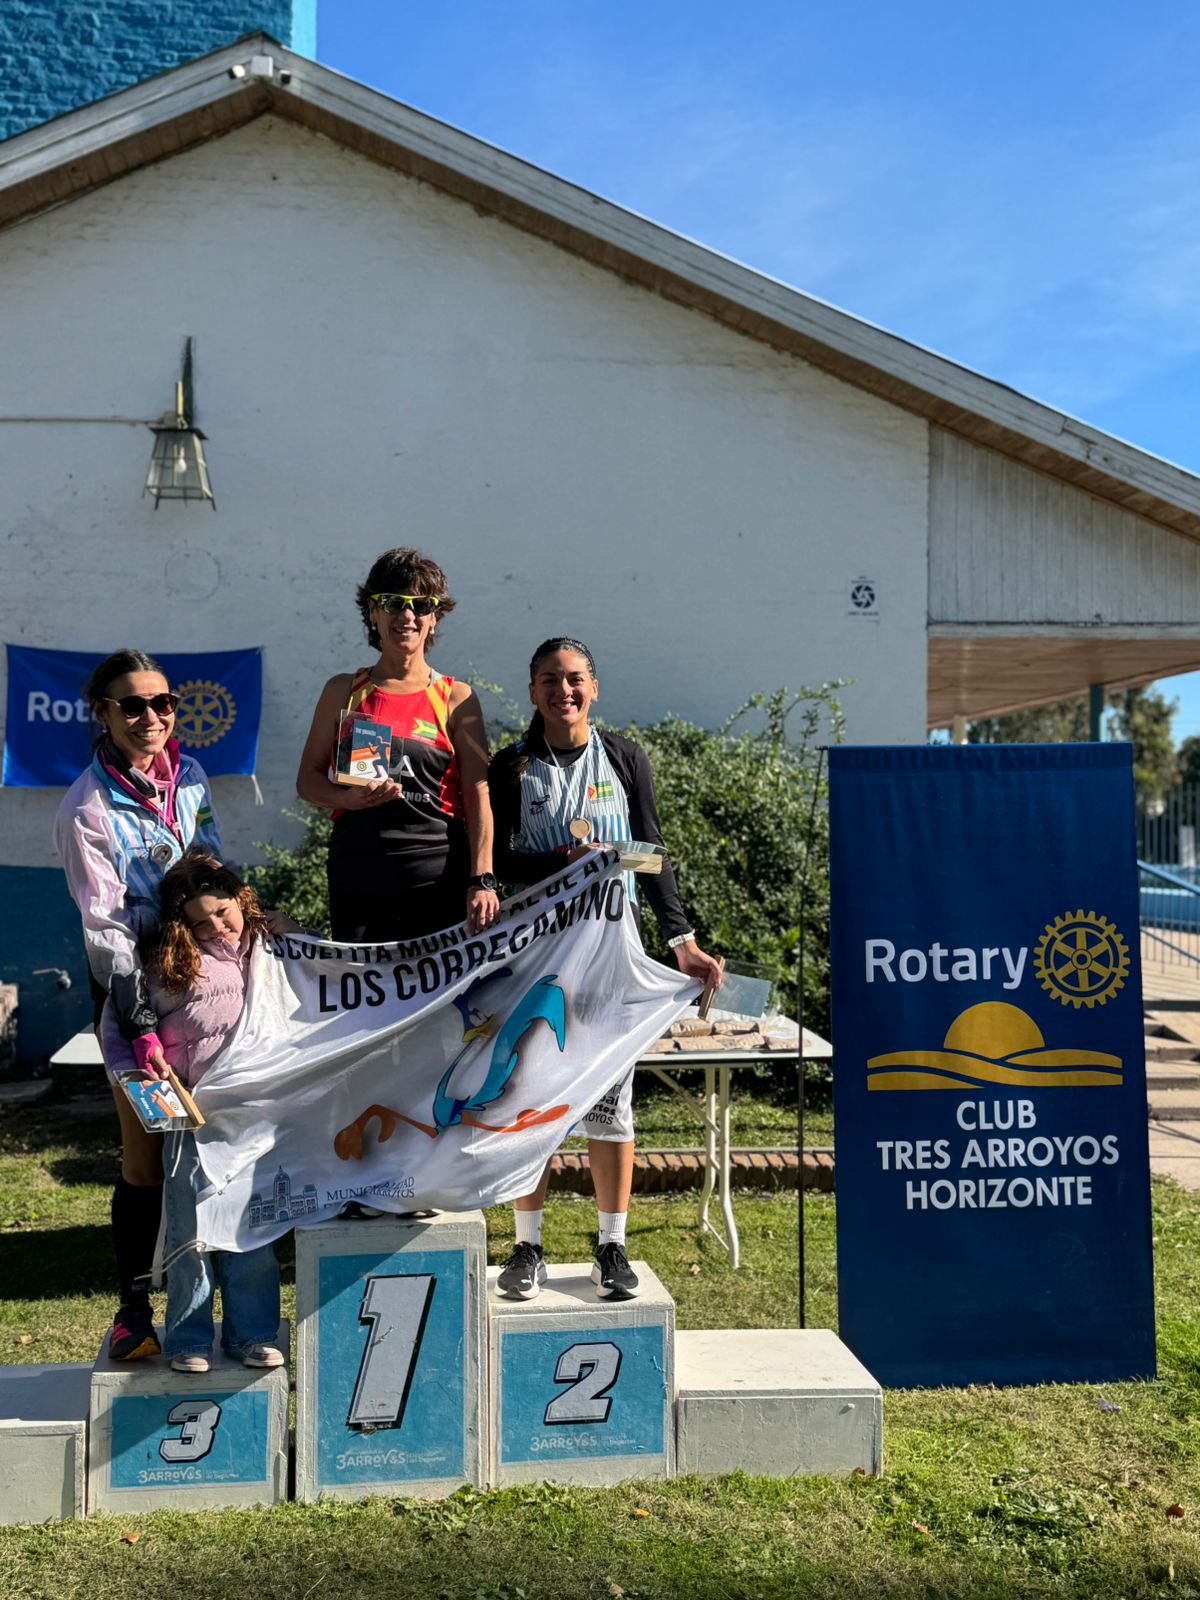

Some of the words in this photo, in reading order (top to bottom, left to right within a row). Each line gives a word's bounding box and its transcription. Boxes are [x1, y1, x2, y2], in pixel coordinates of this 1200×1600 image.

[865, 938, 1029, 990] Rotary
[319, 969, 386, 1013] LOS
[956, 1099, 1038, 1131] CLUB
[876, 1138, 951, 1171] TRES
[960, 1134, 1120, 1169] ARROYOS
[905, 1176, 1093, 1211] HORIZONTE
[344, 1271, 438, 1432] 1
[543, 1340, 623, 1426] 2
[158, 1398, 223, 1464] 3
